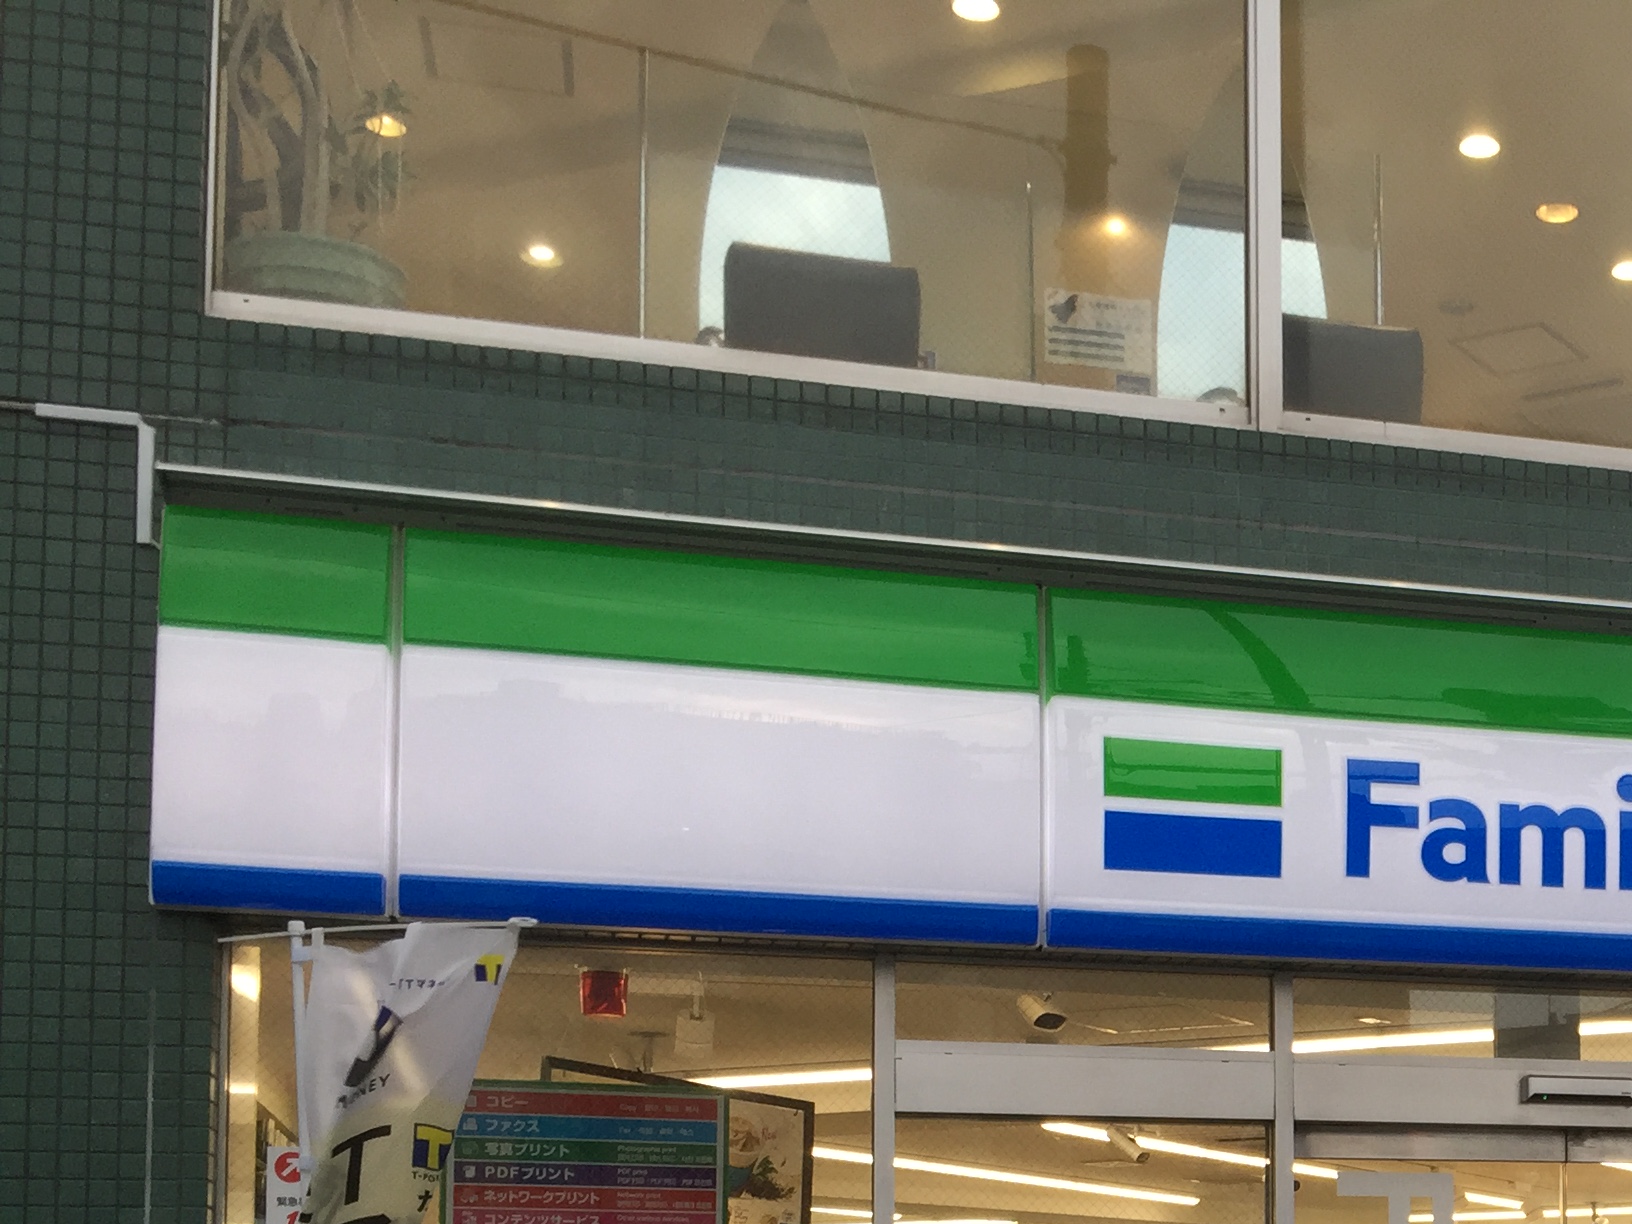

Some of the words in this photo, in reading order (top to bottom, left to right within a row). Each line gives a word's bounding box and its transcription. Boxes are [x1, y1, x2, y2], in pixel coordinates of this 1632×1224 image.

[486, 1096, 529, 1108] コピー
[485, 1119, 540, 1133] ファクス
[484, 1142, 570, 1158] 写真プリント
[484, 1166, 575, 1180] PDFプリント
[484, 1189, 601, 1205] ネットワークプリント
